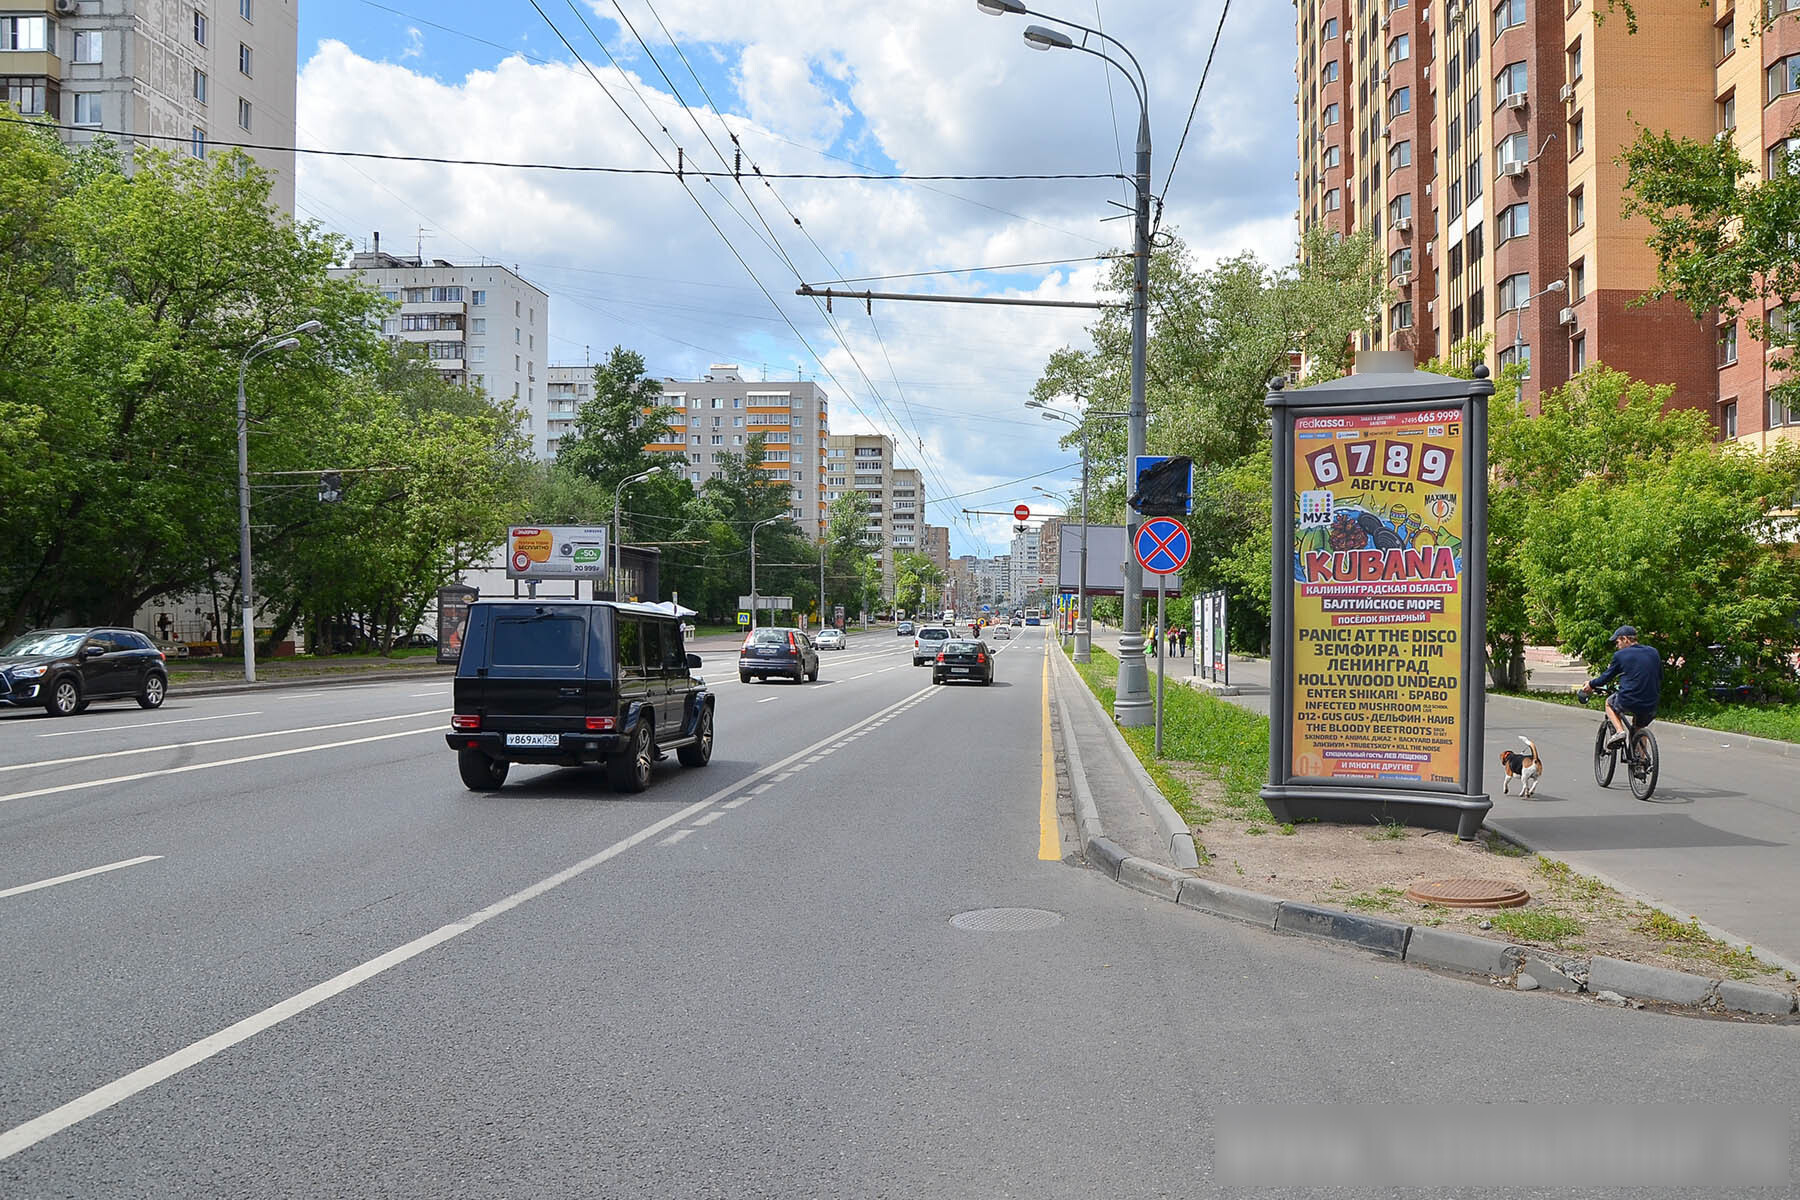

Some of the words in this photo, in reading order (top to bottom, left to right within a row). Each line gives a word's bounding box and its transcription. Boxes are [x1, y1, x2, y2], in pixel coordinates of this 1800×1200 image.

[1300, 418, 1354, 428] redkassa.ru
[1418, 412, 1435, 423] 665
[1436, 410, 1460, 421] 9999
[1314, 452, 1338, 482] 6
[1350, 444, 1370, 472] 7
[1386, 445, 1408, 474] 8
[1422, 450, 1446, 482] 9
[1350, 478, 1414, 494] АВГУСТА
[1424, 494, 1457, 506] MAXIMUM
[1303, 512, 1331, 522] МУЗ
[1305, 546, 1456, 584] KUBANA
[1306, 584, 1408, 596] КАЛИНИНГРАДСКАЯ
[1409, 584, 1453, 592] ОБЛАСТЬ
[1323, 596, 1404, 610] БАЛТИЙСКОЕ
[1406, 600, 1442, 610] МОРЕ
[1338, 614, 1378, 624] ПОСЁЛОК
[1378, 612, 1426, 623] ЯНТАРНЫЙ
[1299, 629, 1352, 642] PANIC!
[1354, 629, 1376, 642] AT
[1378, 630, 1409, 642] THE
[1412, 630, 1457, 643] DISCO
[1314, 643, 1400, 656] ЗЕМФИРА
[1412, 644, 1443, 657] HIM
[1327, 658, 1430, 675] ЛЕНИНГРАД
[1298, 674, 1394, 688] HOLLYWOOD
[1398, 676, 1458, 688] UNDEAD
[1307, 688, 1346, 698] ENTER
[1349, 689, 1398, 700] SHIKARI
[1408, 690, 1448, 701] БРАВО
[1306, 702, 1356, 710] INFECTED
[1358, 702, 1422, 712] MUSHROOM
[1298, 712, 1316, 720] D12
[1322, 712, 1342, 721] GUS
[1344, 712, 1364, 722] GUS
[1370, 714, 1421, 723] ДЕЛЬФИН
[1427, 715, 1454, 724] НАИВ
[1306, 724, 1326, 732] THE
[1329, 724, 1370, 733] BLOODY
[1373, 725, 1432, 736] BEETROOTS
[1382, 763, 1414, 771] ДРУГИЕ!
